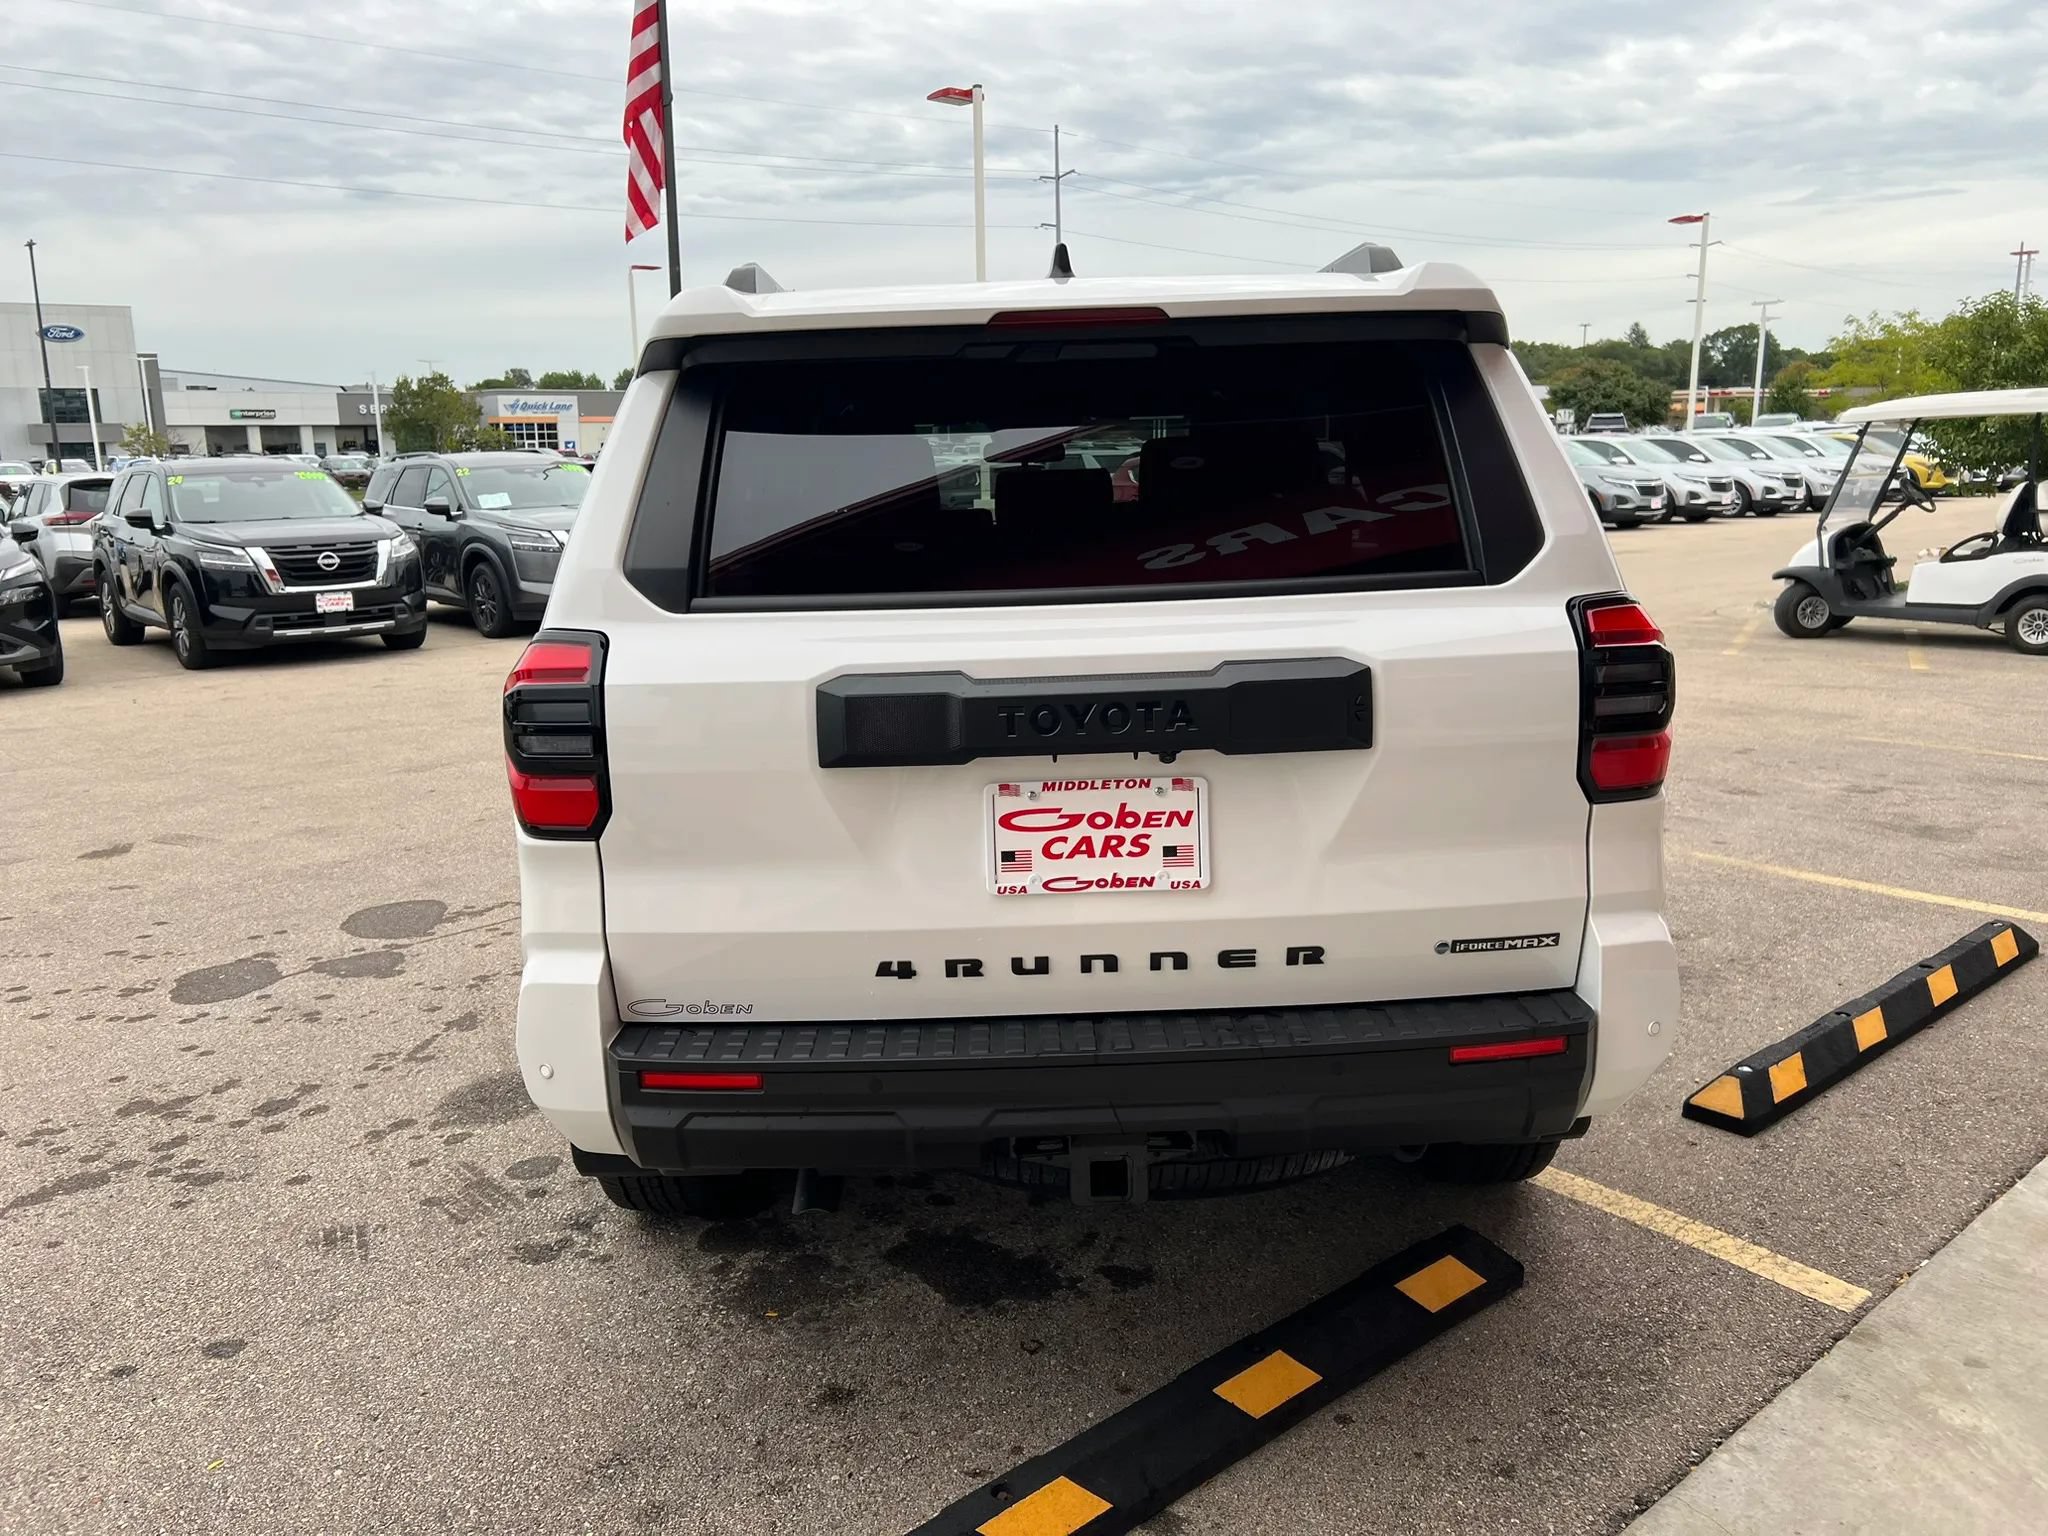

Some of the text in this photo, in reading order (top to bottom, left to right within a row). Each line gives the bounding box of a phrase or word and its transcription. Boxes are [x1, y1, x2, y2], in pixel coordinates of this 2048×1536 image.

[47, 326, 75, 339] Ford
[519, 401, 573, 412] Quick Lane
[997, 700, 1200, 738] TOYOTA
[1041, 778, 1152, 792] MIDDLETON
[1041, 833, 1153, 860] CARS
[996, 885, 1028, 895] USA
[1170, 880, 1202, 890] USA
[875, 946, 1325, 979] 4RUNNER
